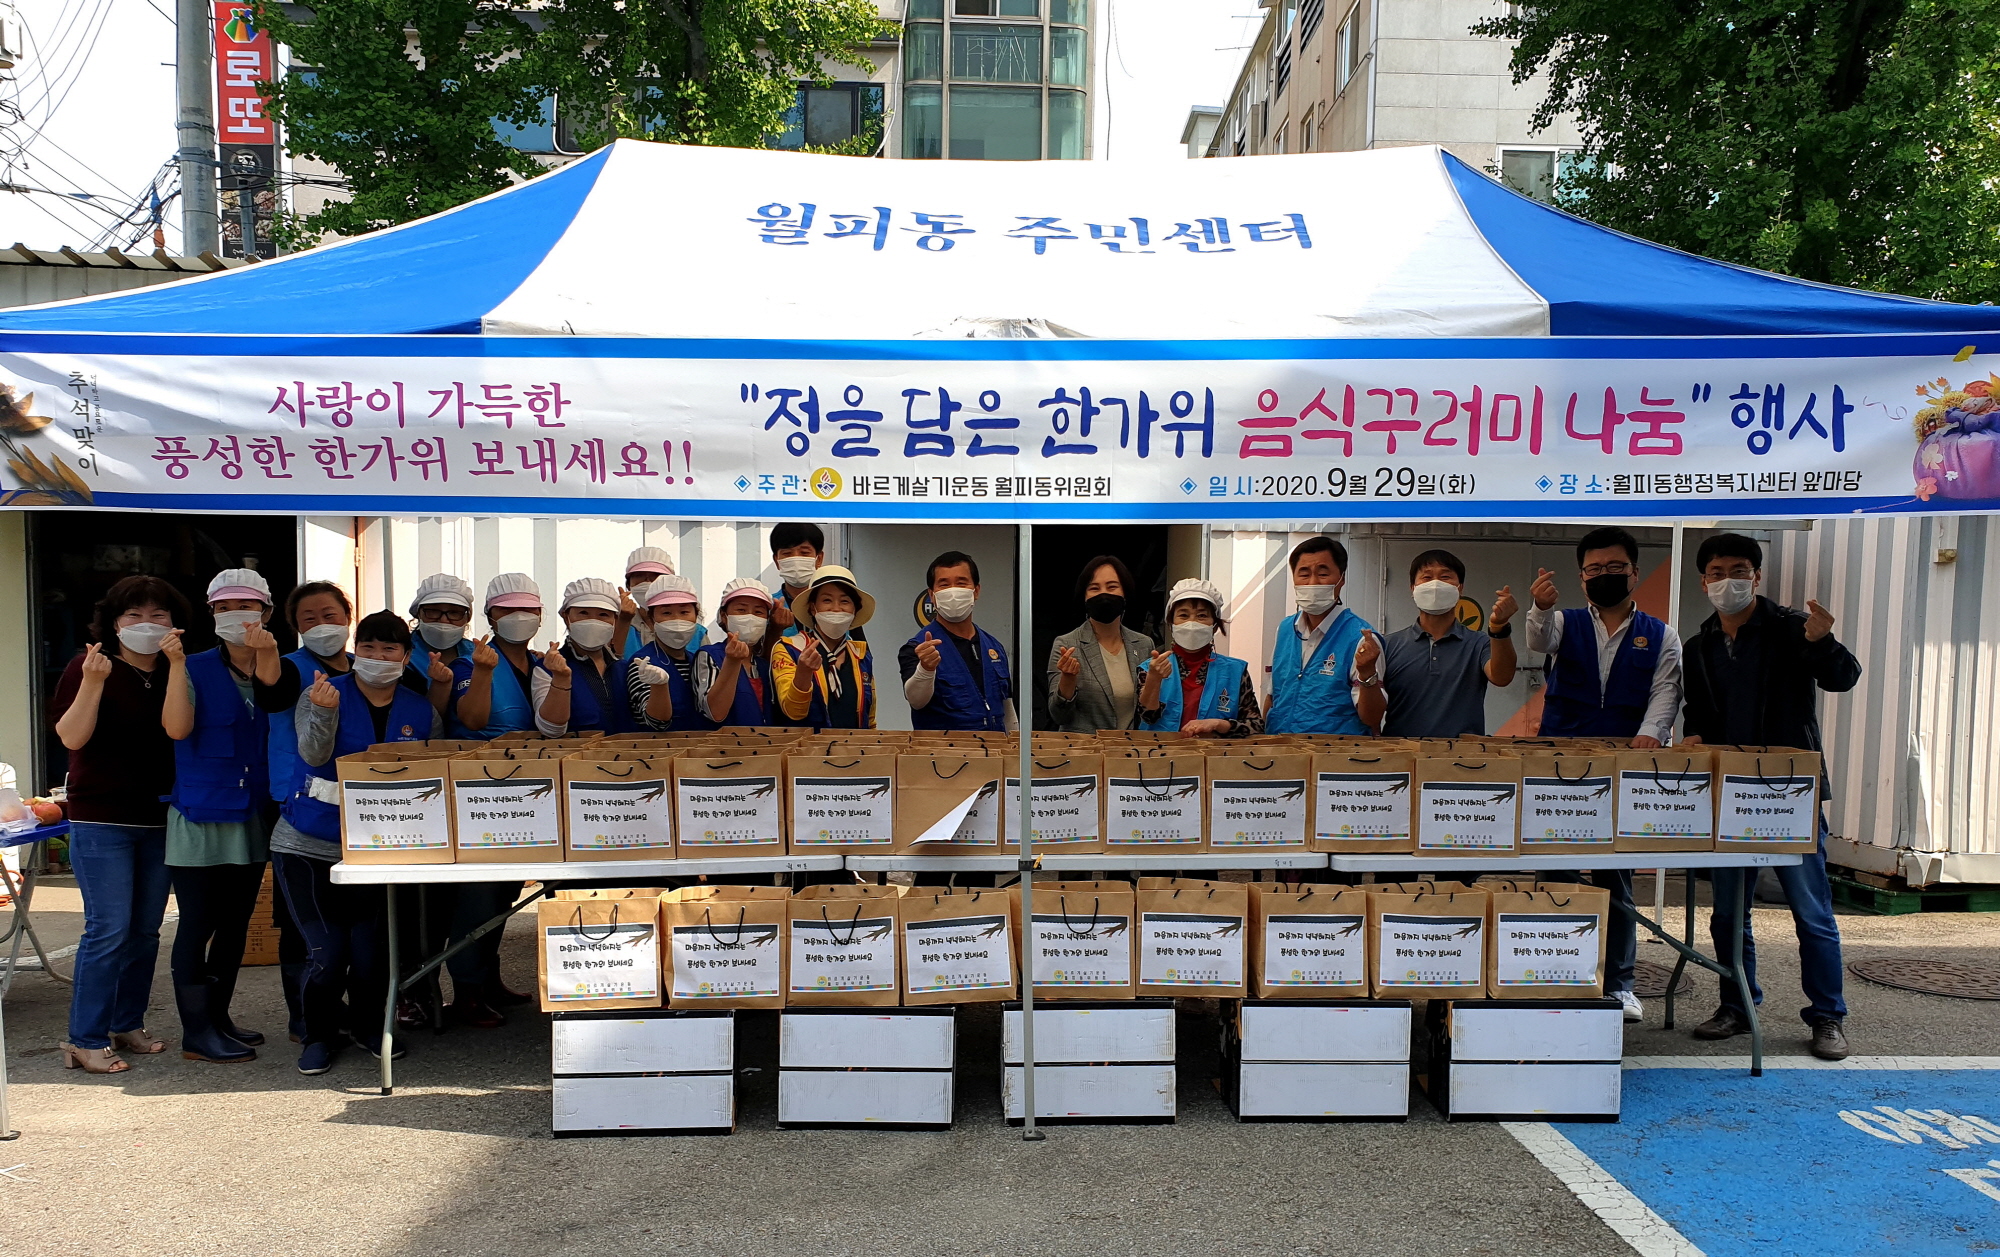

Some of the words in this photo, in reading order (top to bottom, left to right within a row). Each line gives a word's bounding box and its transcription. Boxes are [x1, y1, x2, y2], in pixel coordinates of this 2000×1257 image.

[226, 50, 265, 134] 로또
[746, 202, 976, 253] 월피동
[1002, 213, 1313, 256] 주민센터
[266, 379, 406, 430] 사랑이
[427, 381, 572, 430] 가득한
[68, 370, 99, 477] 추석맞이
[740, 381, 883, 459] "정을
[902, 385, 1020, 459] 담은
[1038, 385, 1214, 460] 한가위
[1238, 385, 1543, 457] 음식꾸러미
[1564, 383, 1711, 457] 나눔"
[1729, 382, 1855, 456] 행사
[151, 435, 296, 481] 풍성한
[308, 437, 450, 483] 한가위
[469, 437, 694, 486] 보내세요!!
[1802, 470, 1862, 492] 앞마당
[852, 476, 989, 497] 바르게살기운동
[995, 476, 1112, 497] 월피동위원회
[1329, 789, 1353, 797] 마음까지
[1355, 789, 1384, 798] 넉넉해지는
[1631, 787, 1655, 796] 마음까지
[467, 796, 490, 804] 마음까지
[492, 795, 524, 804] 넉넉해지는
[690, 794, 713, 803] 마음까지
[715, 794, 746, 803] 넉넉해지는
[805, 794, 830, 802] 마음까지
[831, 794, 862, 802] 넉넉해지는
[1119, 794, 1143, 802] 마음까지
[1223, 797, 1247, 805] 마음까지
[1249, 796, 1278, 805] 넉넉해지는
[1560, 794, 1589, 802] 넉넉해지는
[1735, 792, 1758, 800] 마음까지
[1760, 792, 1787, 801] 넉넉해지는
[355, 798, 379, 806] 마음까지
[381, 797, 412, 807] 넉넉해지는
[580, 798, 604, 807] 마음까지
[605, 798, 636, 807] 넉넉해지는
[1432, 799, 1456, 807] 마음까지
[1457, 799, 1487, 807] 넉넉해지는
[1330, 804, 1349, 813] 풍성한
[1350, 804, 1369, 813] 한가위
[1370, 804, 1393, 813] 보내세요
[1633, 802, 1651, 811] 풍성한
[1653, 803, 1672, 811] 한가위
[1673, 804, 1696, 812] 보내세요
[1735, 807, 1753, 815] 풍성한
[1755, 807, 1773, 815] 한가위
[1774, 807, 1795, 815] 보내세요
[359, 813, 377, 822] 풍성한
[378, 813, 396, 822] 한가위
[399, 812, 424, 822] 보내세요
[470, 810, 488, 820] 풍성한
[489, 810, 508, 819] 한가위
[510, 810, 535, 819] 보내세요
[583, 813, 601, 822] 풍성한
[602, 813, 621, 822] 한가위
[623, 813, 648, 822] 보내세요
[692, 810, 710, 819] 풍성한
[712, 809, 731, 818] 한가위
[733, 808, 757, 817] 보내세요
[808, 809, 826, 817] 풍성한
[828, 809, 847, 818] 한가위
[849, 808, 872, 817] 보내세요
[1038, 809, 1056, 818] 한가위
[1057, 808, 1080, 817] 보내세요
[1121, 809, 1139, 818] 풍성한
[1141, 809, 1159, 818] 한가위
[1161, 809, 1182, 817] 보내세요
[1225, 811, 1243, 820] 풍성한
[1245, 811, 1263, 820] 한가위
[1264, 811, 1287, 820] 보내세요
[1434, 813, 1452, 822] 풍성한
[1453, 813, 1472, 822] 한가위
[1473, 814, 1496, 822] 보내세요
[1535, 809, 1553, 817] 풍성한
[1555, 809, 1573, 817] 한가위
[1575, 809, 1597, 817] 보내세요
[1040, 932, 1064, 940] 마음까지
[1154, 931, 1178, 940] 마음까지
[1181, 931, 1212, 940] 넉넉해지는
[1278, 932, 1304, 940] 마음까지
[1305, 932, 1336, 941] 넉넉해지는
[1394, 932, 1420, 941] 마음까지
[1422, 933, 1452, 942] 넉넉해지는
[1511, 931, 1536, 940] 마음까지
[1538, 932, 1569, 940] 넉넉해지는
[803, 938, 829, 946] 마음까지
[919, 938, 944, 946] 마음까지
[946, 935, 977, 945] 넉넉해지는
[559, 943, 587, 952] 마음까지
[588, 943, 622, 952] 넉넉해지는
[685, 943, 711, 952] 마음까지
[1156, 947, 1174, 956] 풍성한
[1176, 947, 1196, 956] 한가위
[1198, 948, 1222, 957] 보내세요
[1513, 947, 1532, 956] 풍성한
[1534, 948, 1554, 957] 한가위
[1555, 948, 1579, 957] 보내세요
[921, 953, 940, 963] 풍성한
[942, 953, 963, 962] 한가위
[964, 951, 989, 960] 보내세요
[1042, 948, 1061, 957] 풍성한
[1062, 948, 1082, 957] 한가위
[1085, 948, 1108, 957] 보내세요
[1280, 948, 1299, 957] 풍성한
[1301, 948, 1321, 957] 한가위
[1322, 948, 1345, 957] 보내세요
[1396, 948, 1415, 957] 풍성한
[1417, 948, 1437, 958] 한가위
[1438, 949, 1462, 958] 보내세요
[805, 954, 824, 963] 풍성한
[826, 954, 846, 963] 한가위
[848, 954, 873, 962] 보내세요
[563, 960, 582, 970] 풍성한
[584, 960, 605, 969] 한가위
[607, 959, 633, 968] 보내세요
[687, 959, 707, 969] 풍성한
[709, 959, 730, 969] 한가위
[732, 959, 757, 967] 보내세요
